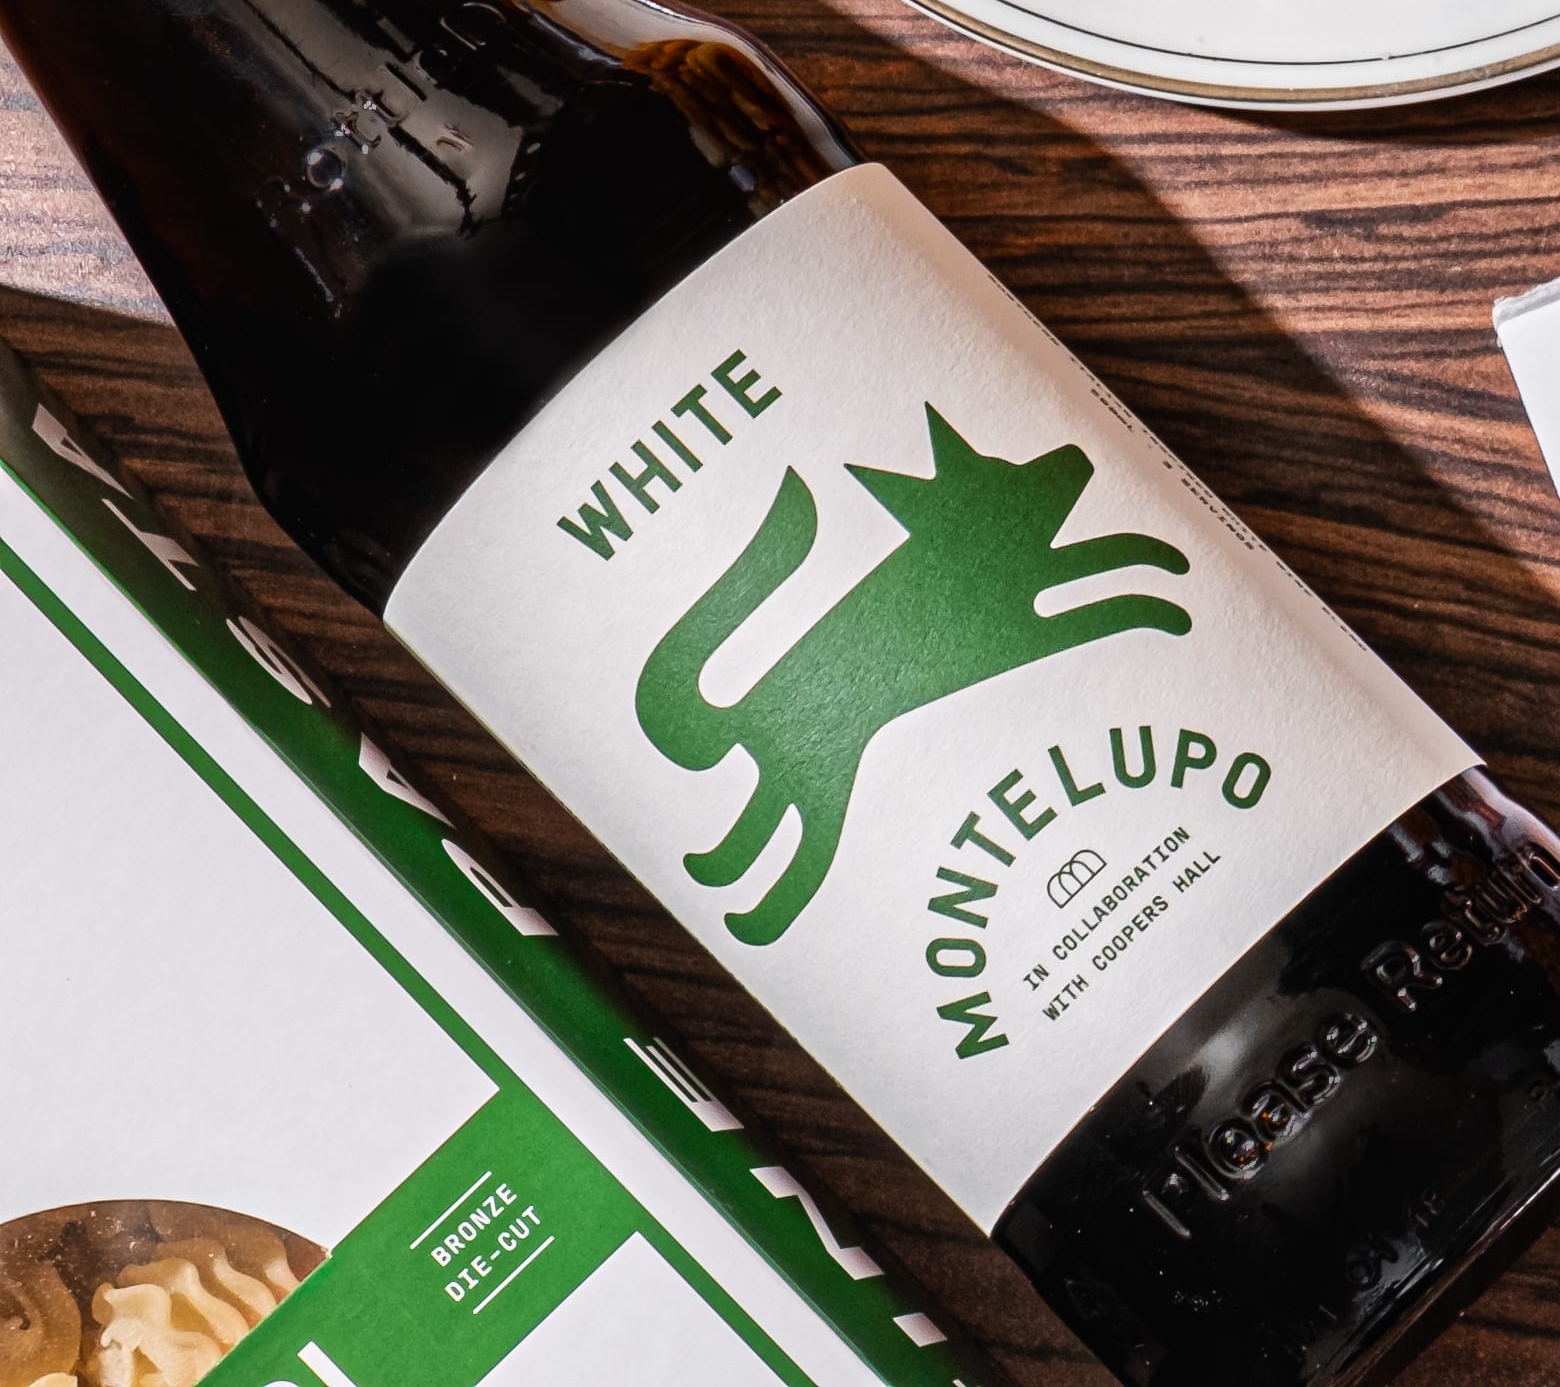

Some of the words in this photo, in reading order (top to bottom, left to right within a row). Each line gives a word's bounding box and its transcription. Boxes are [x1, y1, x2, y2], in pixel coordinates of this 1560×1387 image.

[557, 349, 782, 561] WHITE
[30, 402, 560, 936] PASTA
[925, 725, 1271, 1059] MONTELUPO
[1023, 964, 1050, 991] IN
[1052, 826, 1191, 961] COLLABORATION
[1042, 973, 1090, 1021] WITH
[1092, 895, 1168, 972] COOPERS
[1173, 850, 1221, 893] HALL
[431, 1183, 518, 1268] BRONZE
[444, 1204, 543, 1304] DIE-CUT
[622, 1036, 967, 1387] INE
